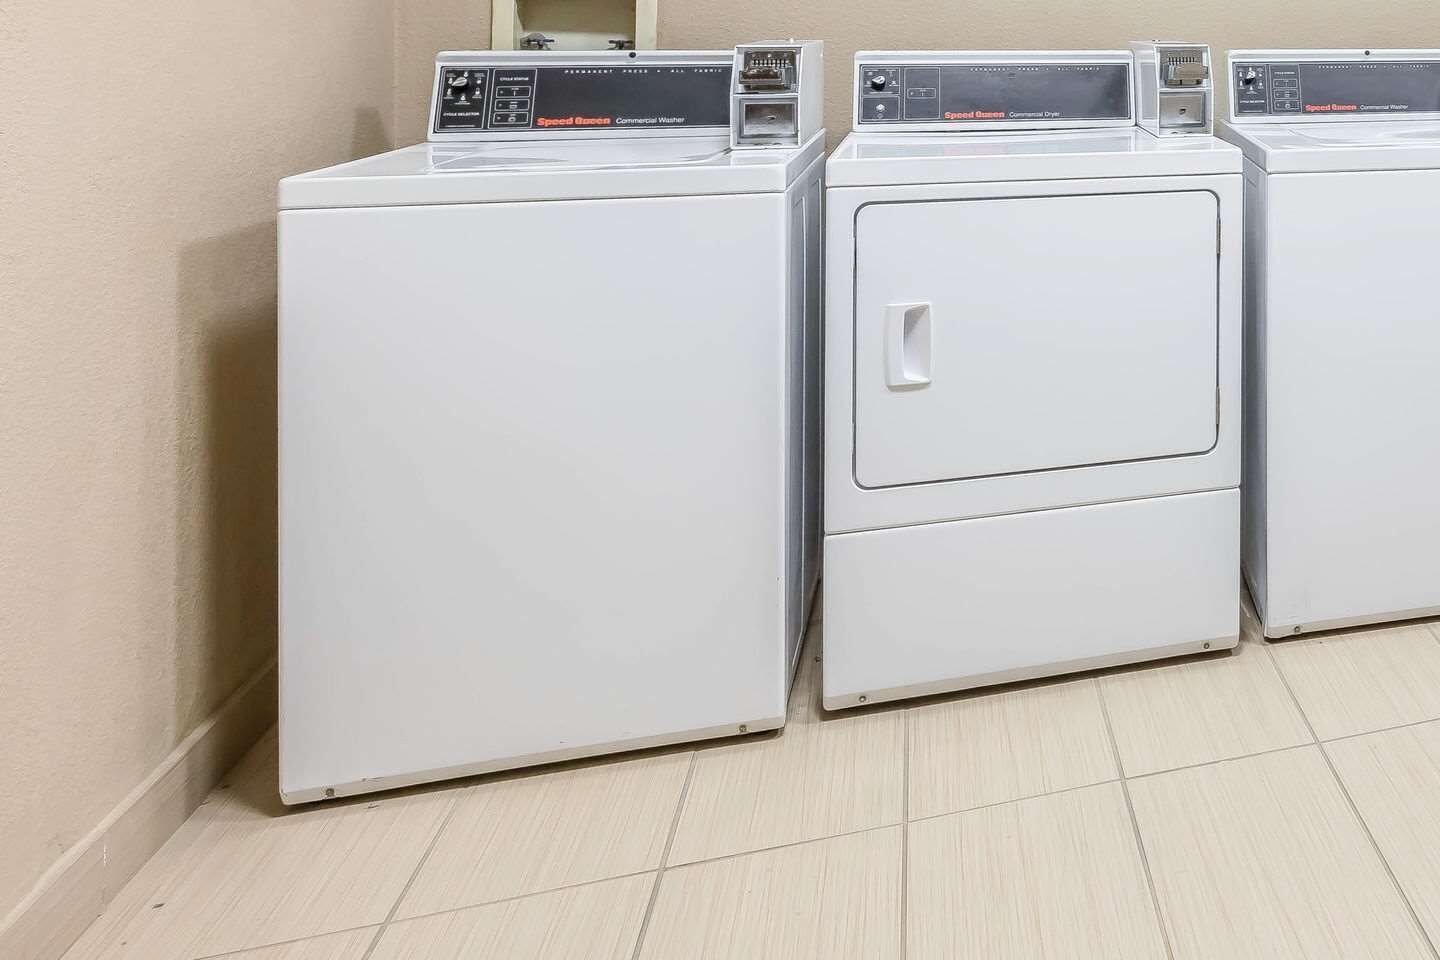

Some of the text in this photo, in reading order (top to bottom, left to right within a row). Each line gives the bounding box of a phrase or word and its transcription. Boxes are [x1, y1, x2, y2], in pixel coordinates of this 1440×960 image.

[1305, 104, 1331, 112] Speed
[944, 111, 974, 120] Speed
[975, 110, 1005, 118] Queen
[537, 117, 573, 127] Speed
[575, 117, 611, 125] Queen
